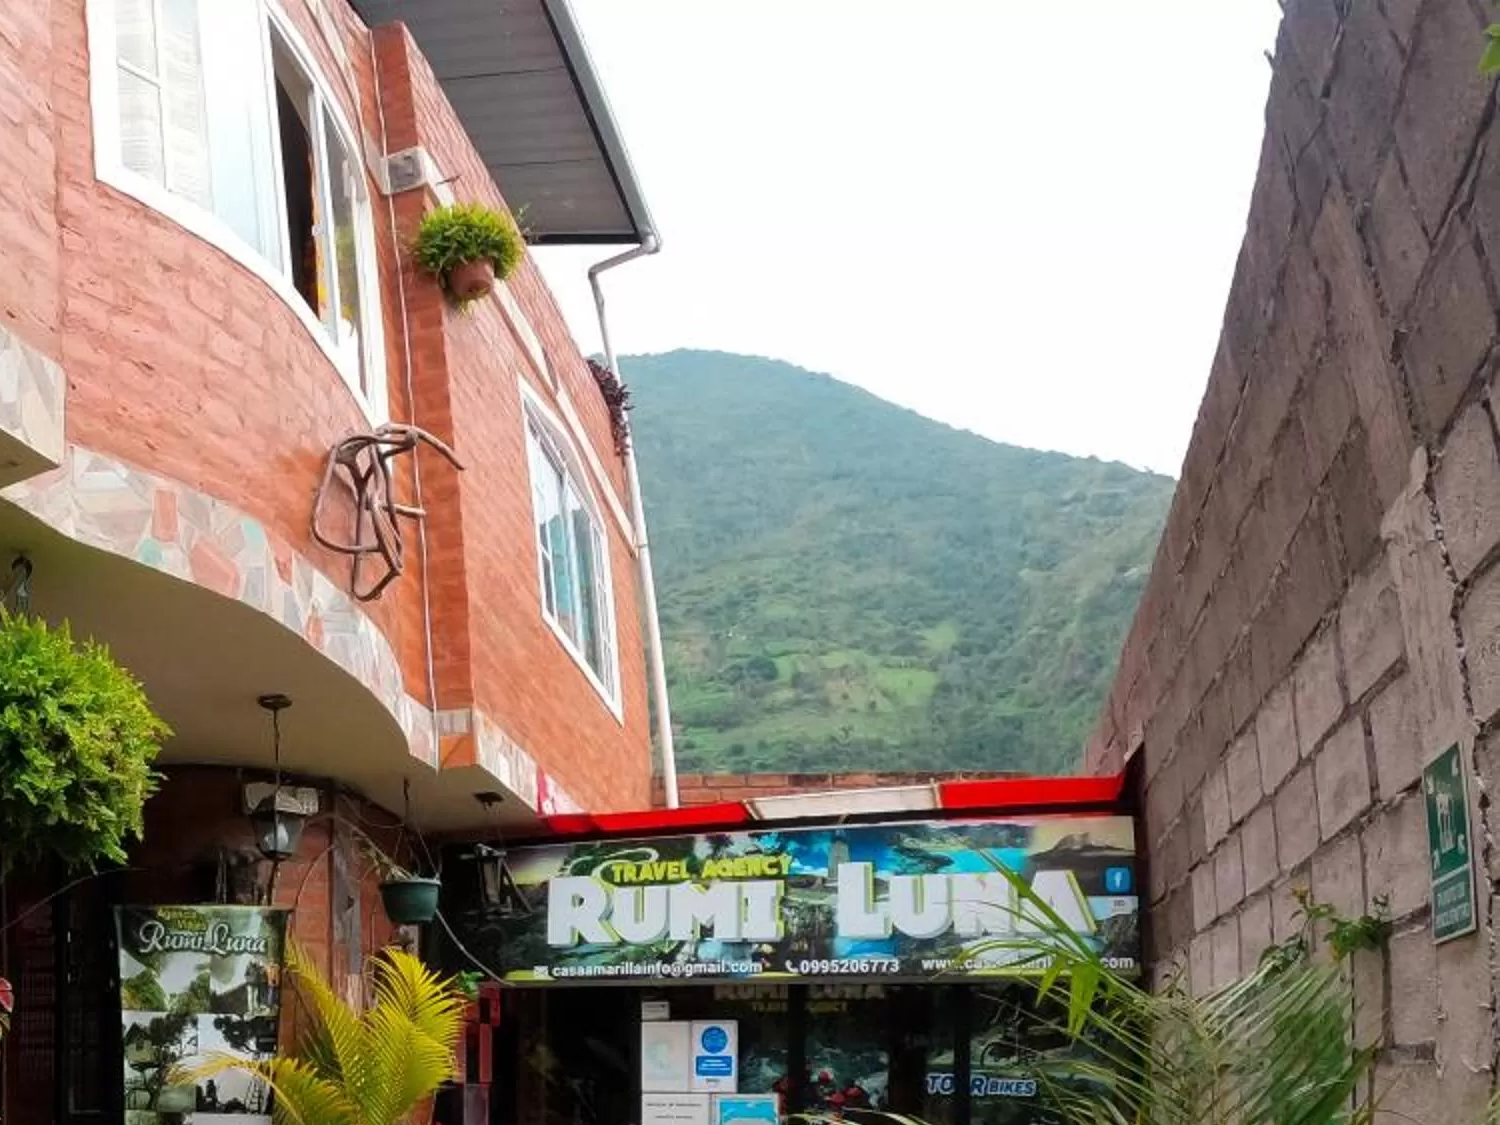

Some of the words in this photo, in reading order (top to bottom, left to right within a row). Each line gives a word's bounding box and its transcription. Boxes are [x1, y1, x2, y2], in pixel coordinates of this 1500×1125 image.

[612, 861, 690, 883] TRAVEL
[701, 855, 792, 877] AGENCY
[547, 875, 785, 946] RUMI
[837, 861, 1098, 940] LUNA
[139, 920, 204, 953] Rumi
[203, 922, 267, 955] Luna
[552, 959, 763, 977] casaamarillainfo@gmail.com
[800, 959, 900, 975] 0995206773
[926, 1072, 987, 1096] TOR
[988, 1080, 1036, 1096] BIKES
